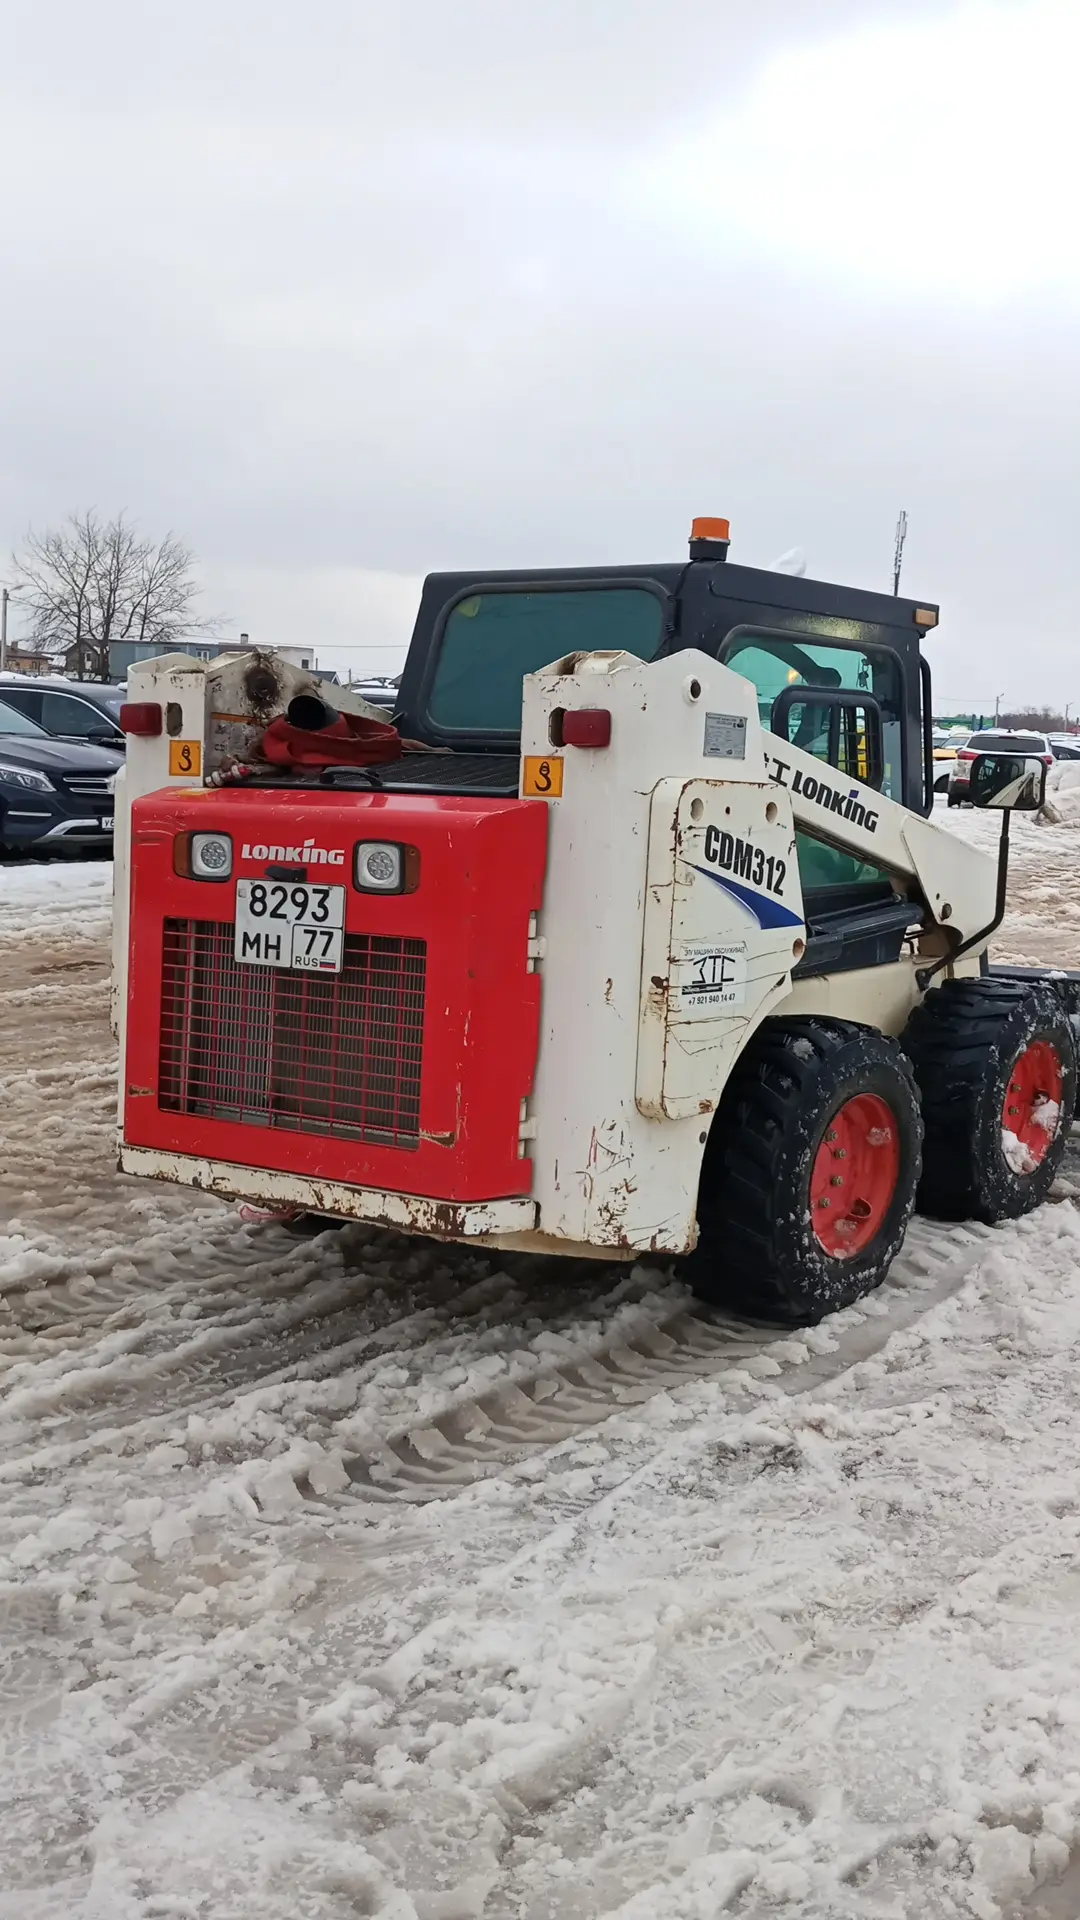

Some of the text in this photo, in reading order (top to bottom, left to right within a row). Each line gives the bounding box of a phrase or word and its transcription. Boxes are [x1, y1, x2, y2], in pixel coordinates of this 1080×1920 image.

[241, 838, 345, 865] LONKING
[704, 824, 786, 896] CDM312
[249, 884, 330, 923] 8293
[303, 929, 334, 957] 77
[295, 957, 318, 967] RUS
[696, 996, 707, 1004] 921
[708, 995, 720, 1003] 940
[720, 993, 728, 1002] 14
[728, 992, 736, 1001] 47
